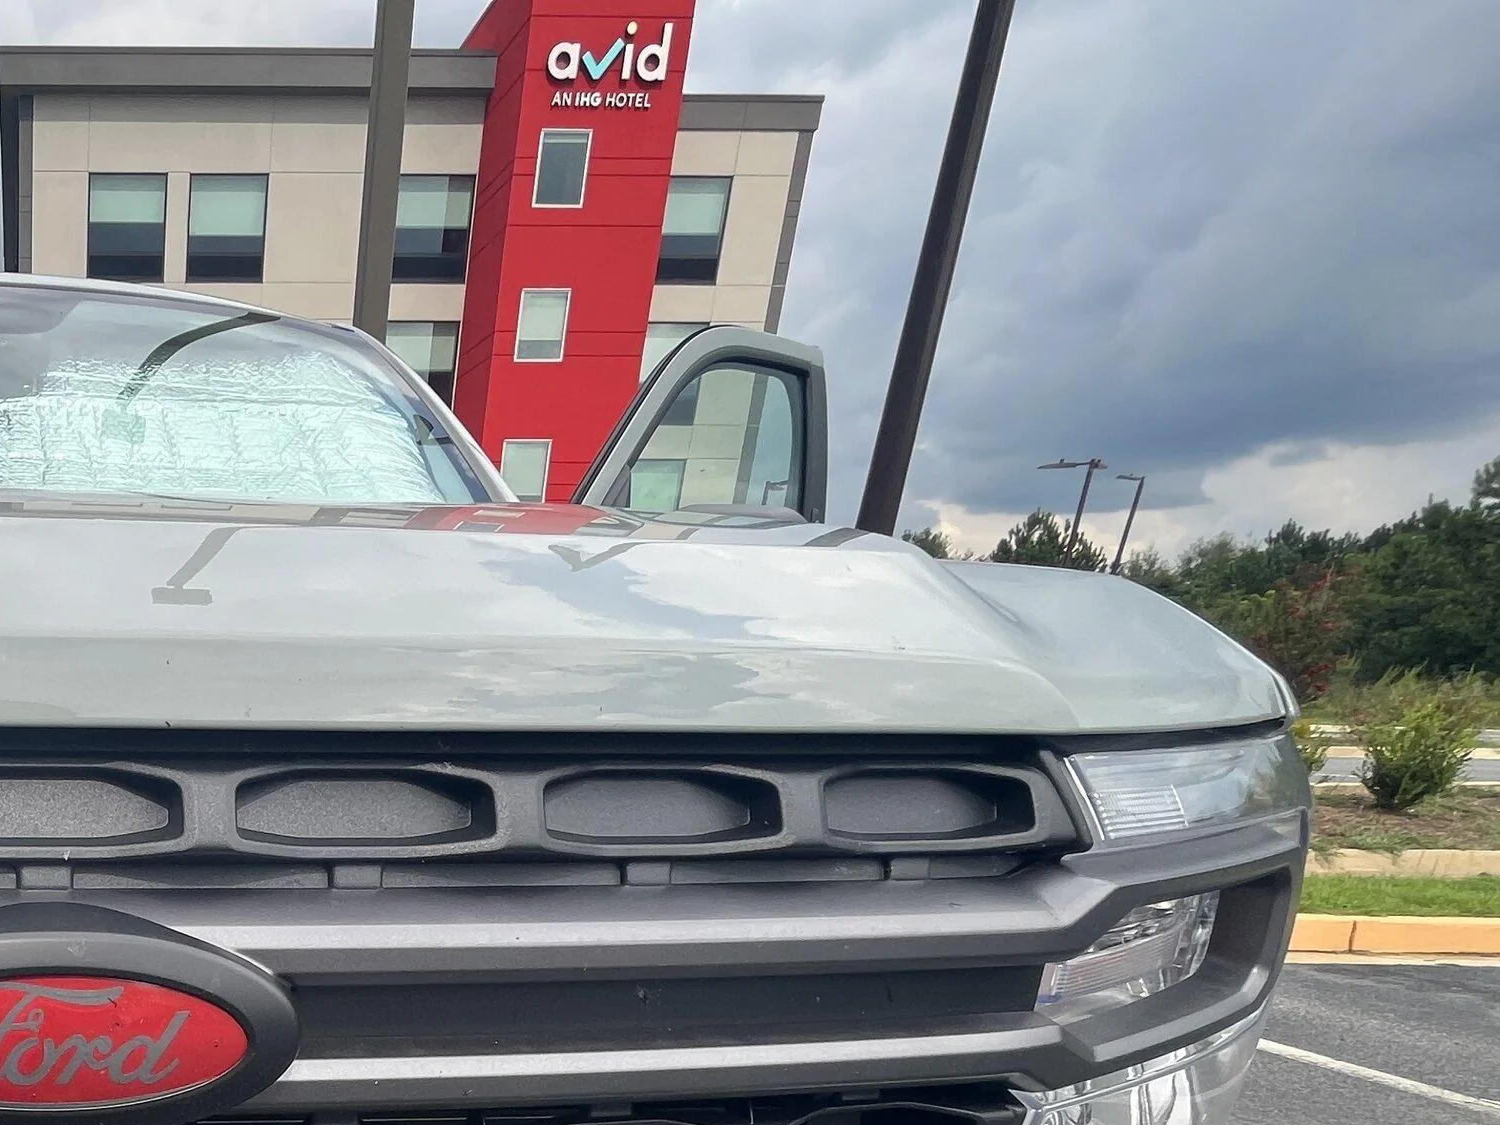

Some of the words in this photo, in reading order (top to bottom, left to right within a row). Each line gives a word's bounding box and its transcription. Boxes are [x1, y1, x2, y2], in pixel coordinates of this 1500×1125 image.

[547, 21, 674, 82] avid
[551, 91, 572, 107] AN
[574, 91, 602, 107] IHG
[605, 92, 652, 108] HOTEL
